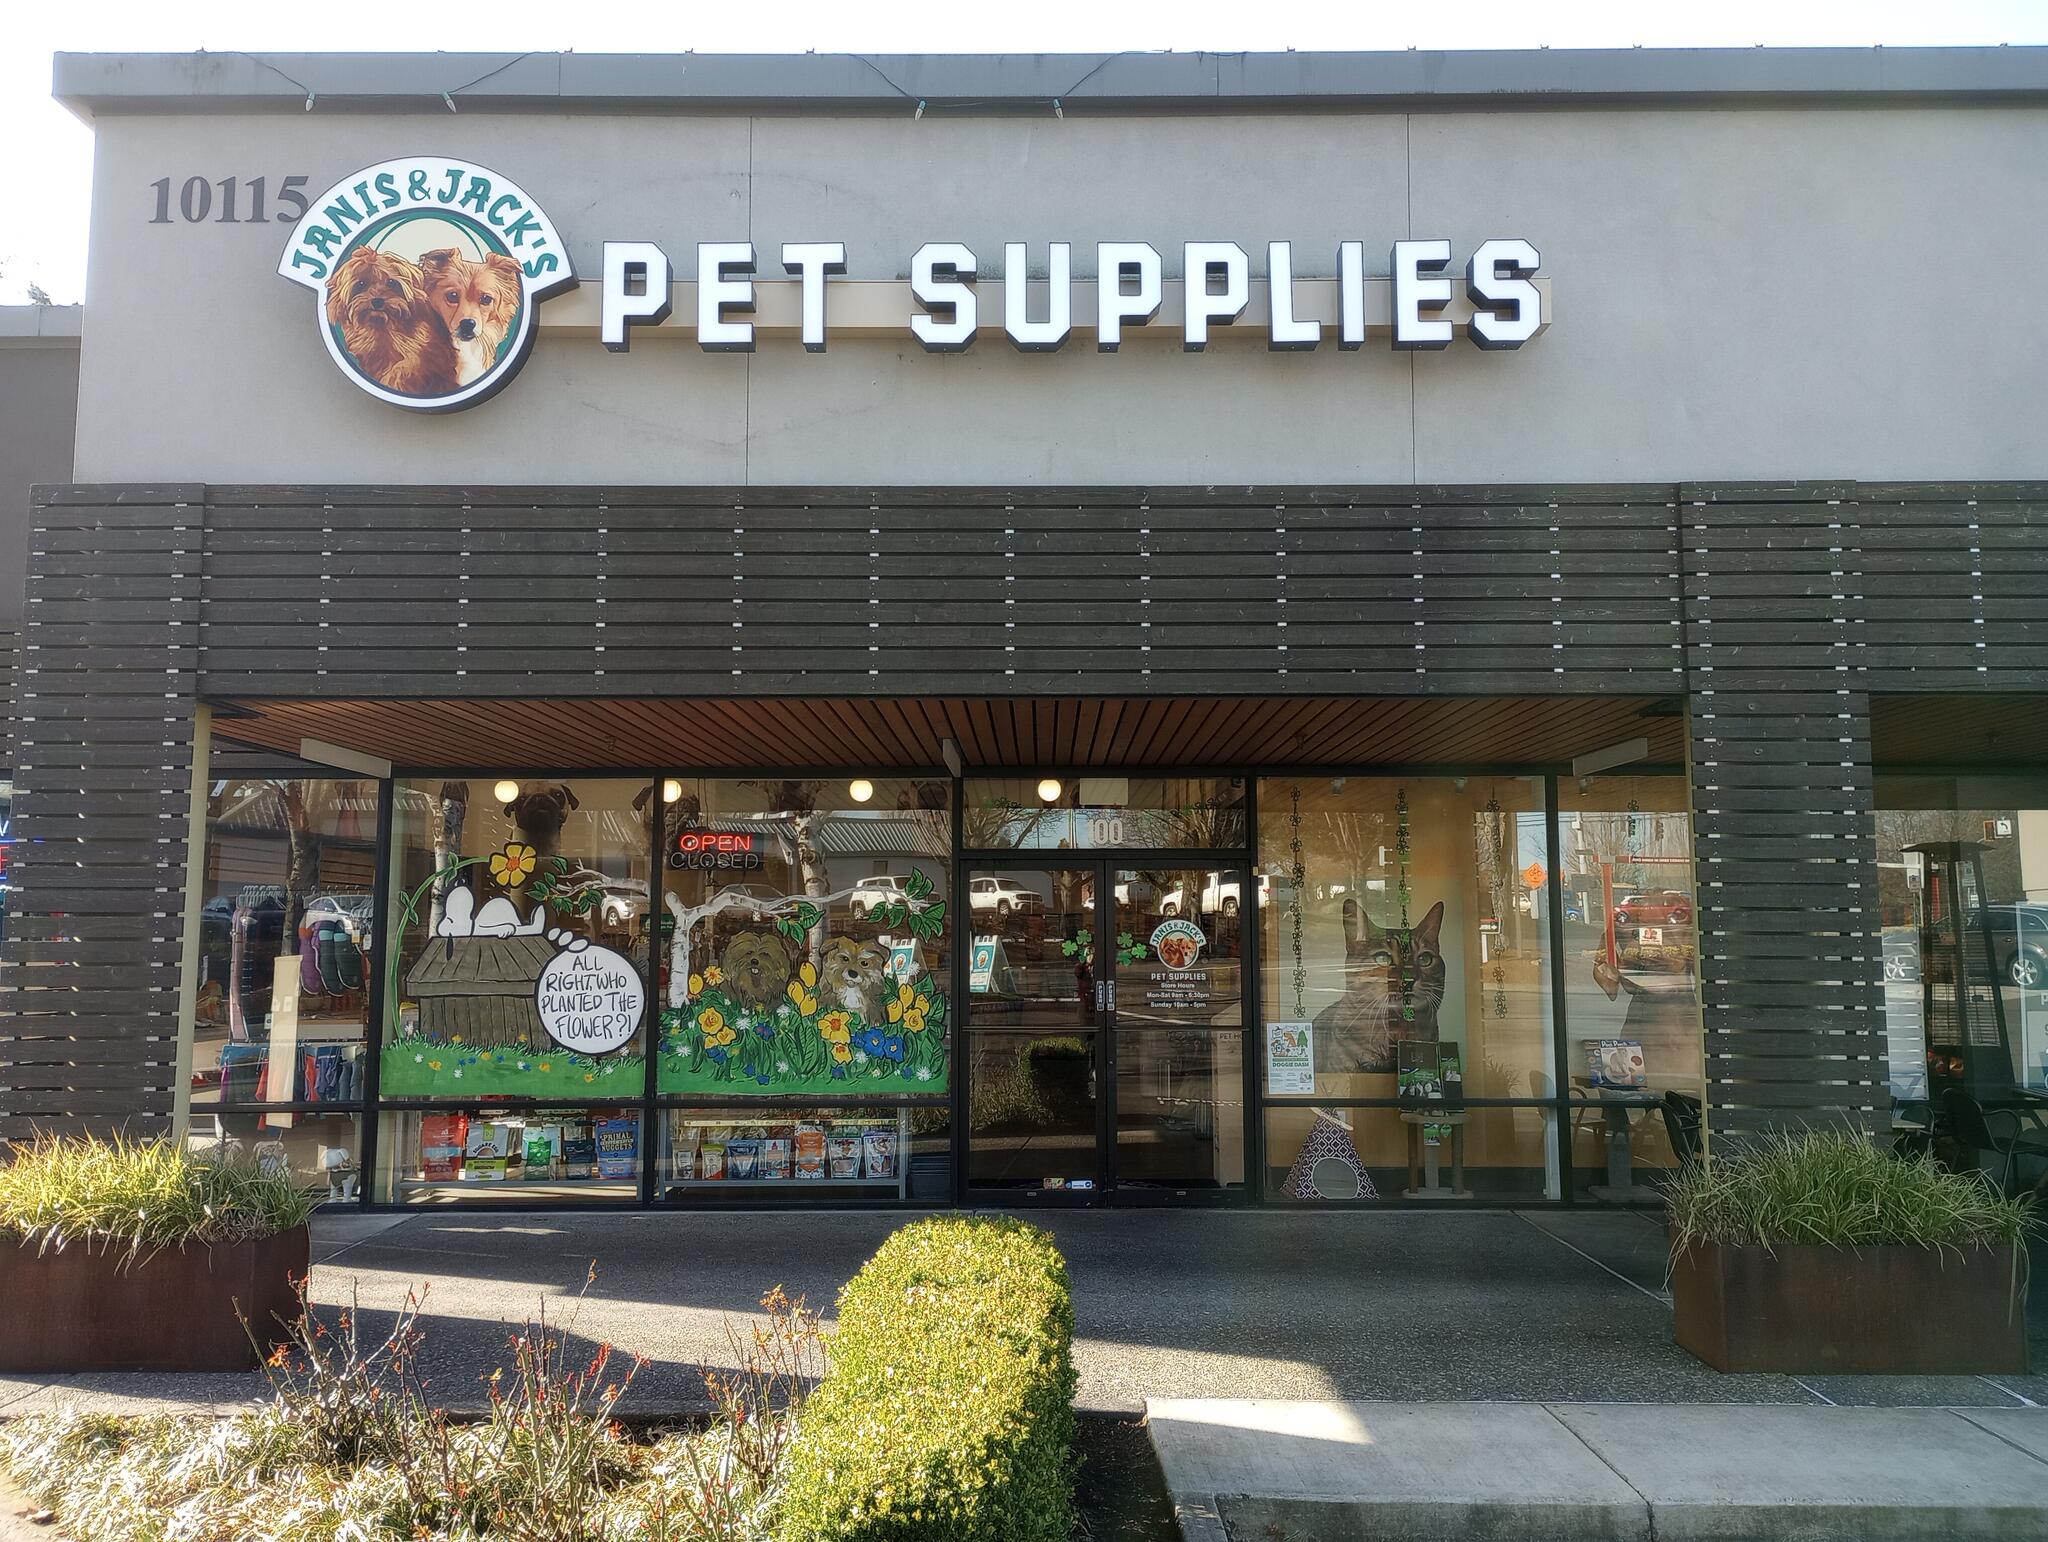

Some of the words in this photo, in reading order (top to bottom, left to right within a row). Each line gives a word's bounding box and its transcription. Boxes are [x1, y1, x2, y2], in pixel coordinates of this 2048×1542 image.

[148, 175, 309, 224] 10115
[601, 240, 848, 351] PET
[910, 238, 1542, 353] SUPPLIES
[1087, 818, 1123, 845] 100
[680, 834, 750, 852] OPEN
[670, 851, 759, 870] CLOSED
[572, 954, 604, 972] ALL
[596, 971, 627, 990] WHO
[1151, 972, 1167, 981] PET
[1168, 972, 1207, 981] SUPPLIES
[541, 992, 603, 1014] PLANTED
[604, 991, 637, 1012] THE
[1150, 1001, 1173, 1009] Sunday
[602, 1131, 632, 1142] PRIMAL
[601, 1142, 633, 1152] NUGGETS
